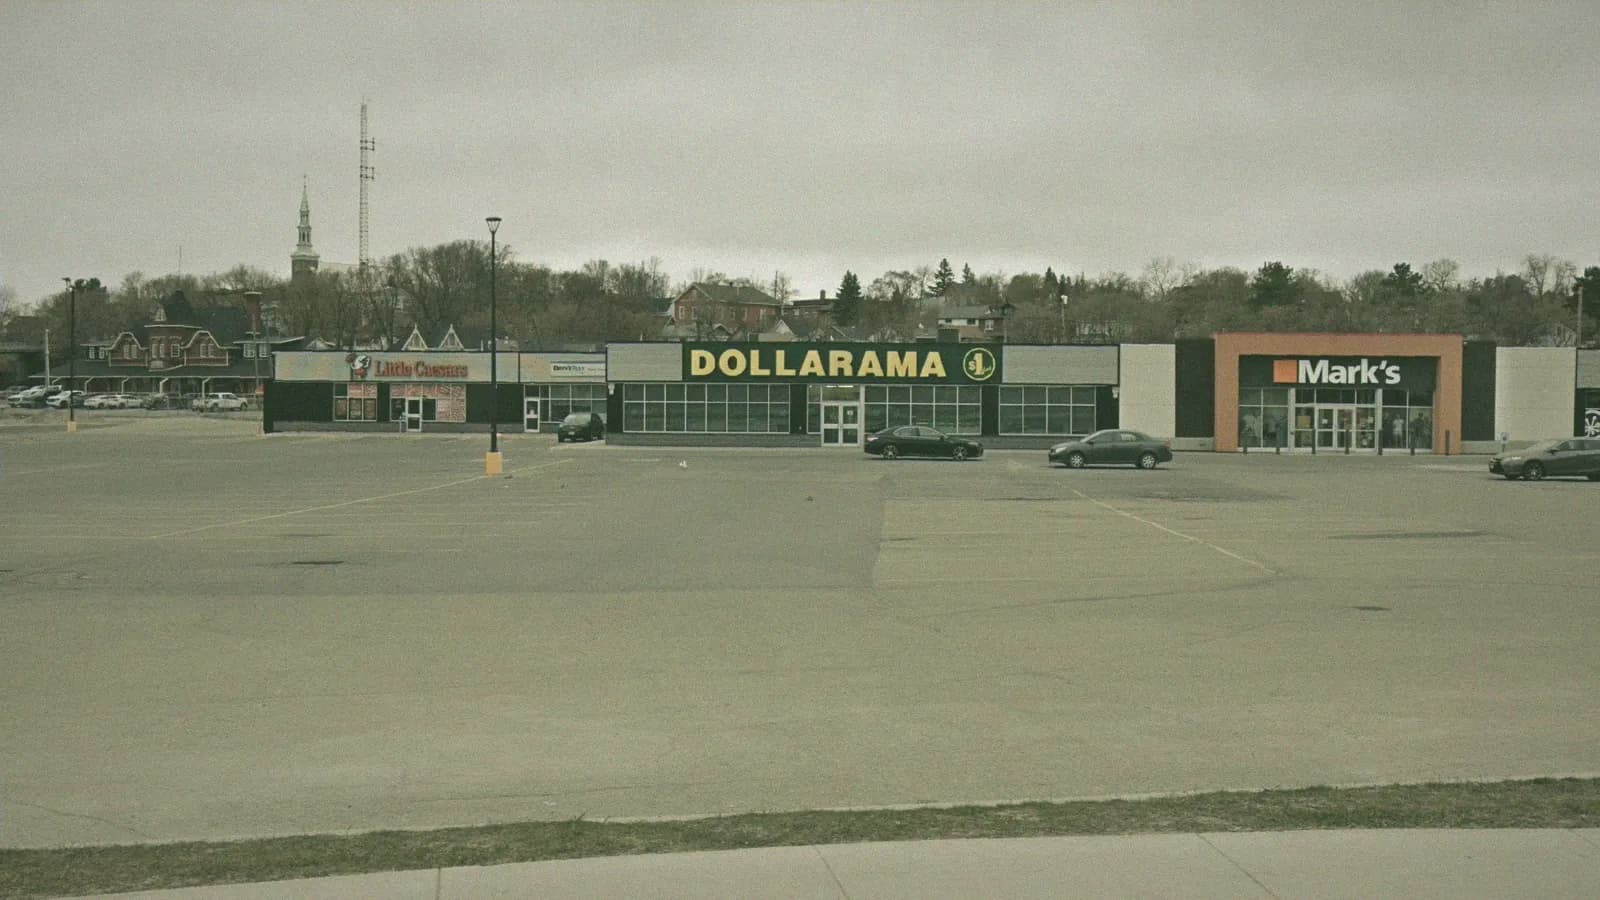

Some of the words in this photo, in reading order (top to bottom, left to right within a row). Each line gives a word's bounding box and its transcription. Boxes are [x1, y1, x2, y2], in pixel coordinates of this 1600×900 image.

[374, 360, 413, 377] Little
[415, 360, 468, 377] Caesars
[691, 349, 947, 377] DOLLARAMA
[1298, 358, 1401, 384] Mark's
